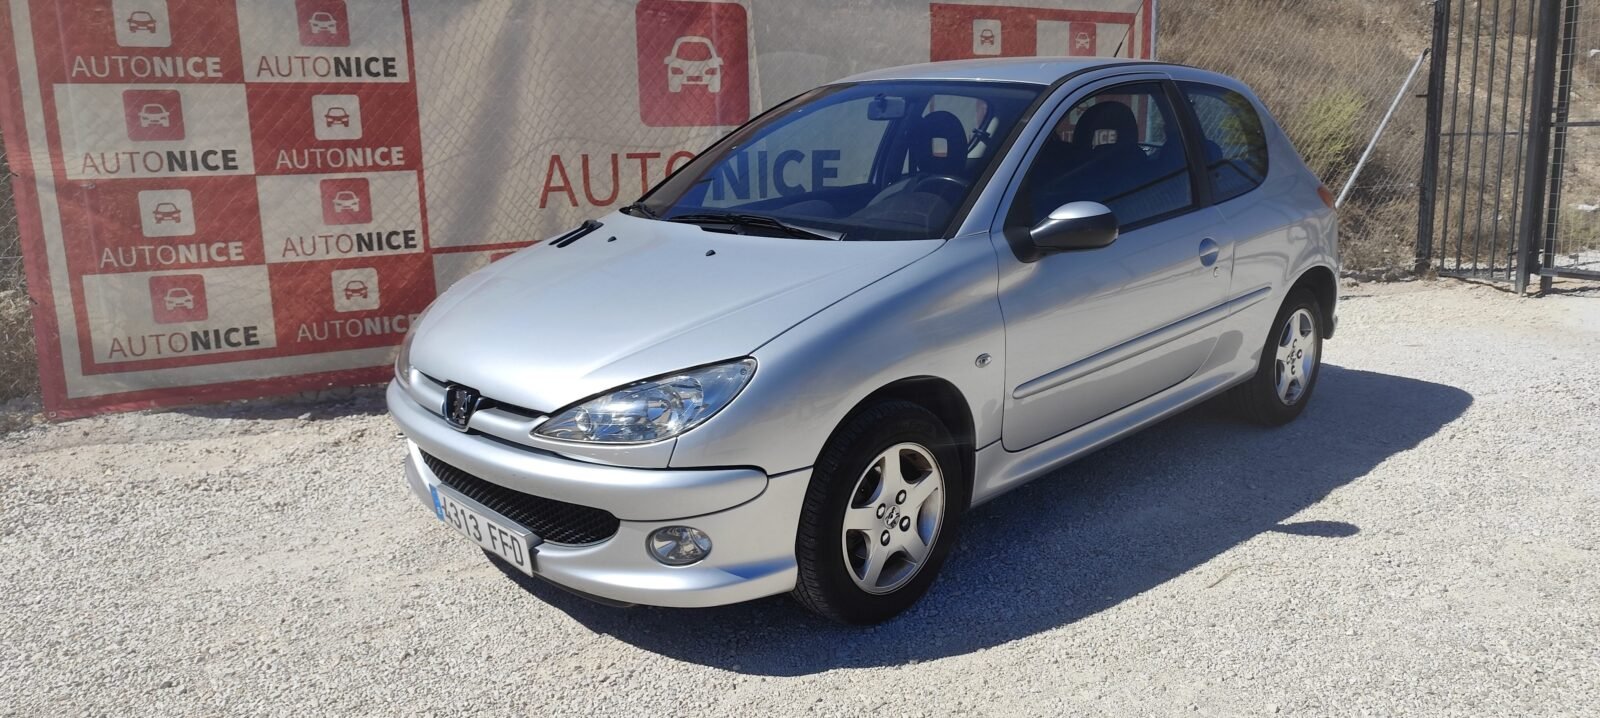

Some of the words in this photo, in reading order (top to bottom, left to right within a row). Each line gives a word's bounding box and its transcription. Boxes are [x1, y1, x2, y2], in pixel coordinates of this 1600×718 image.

[72, 55, 223, 78] AUTONICE
[256, 55, 398, 78] AUTONICE
[82, 149, 239, 175] AUTONICE
[276, 146, 406, 170] AUTONICE
[100, 241, 245, 268] AUTONICE
[282, 230, 418, 258] AUTONICE
[108, 325, 260, 360] AUTONICE
[441, 496, 483, 543] 4313
[487, 521, 524, 567] FFD
